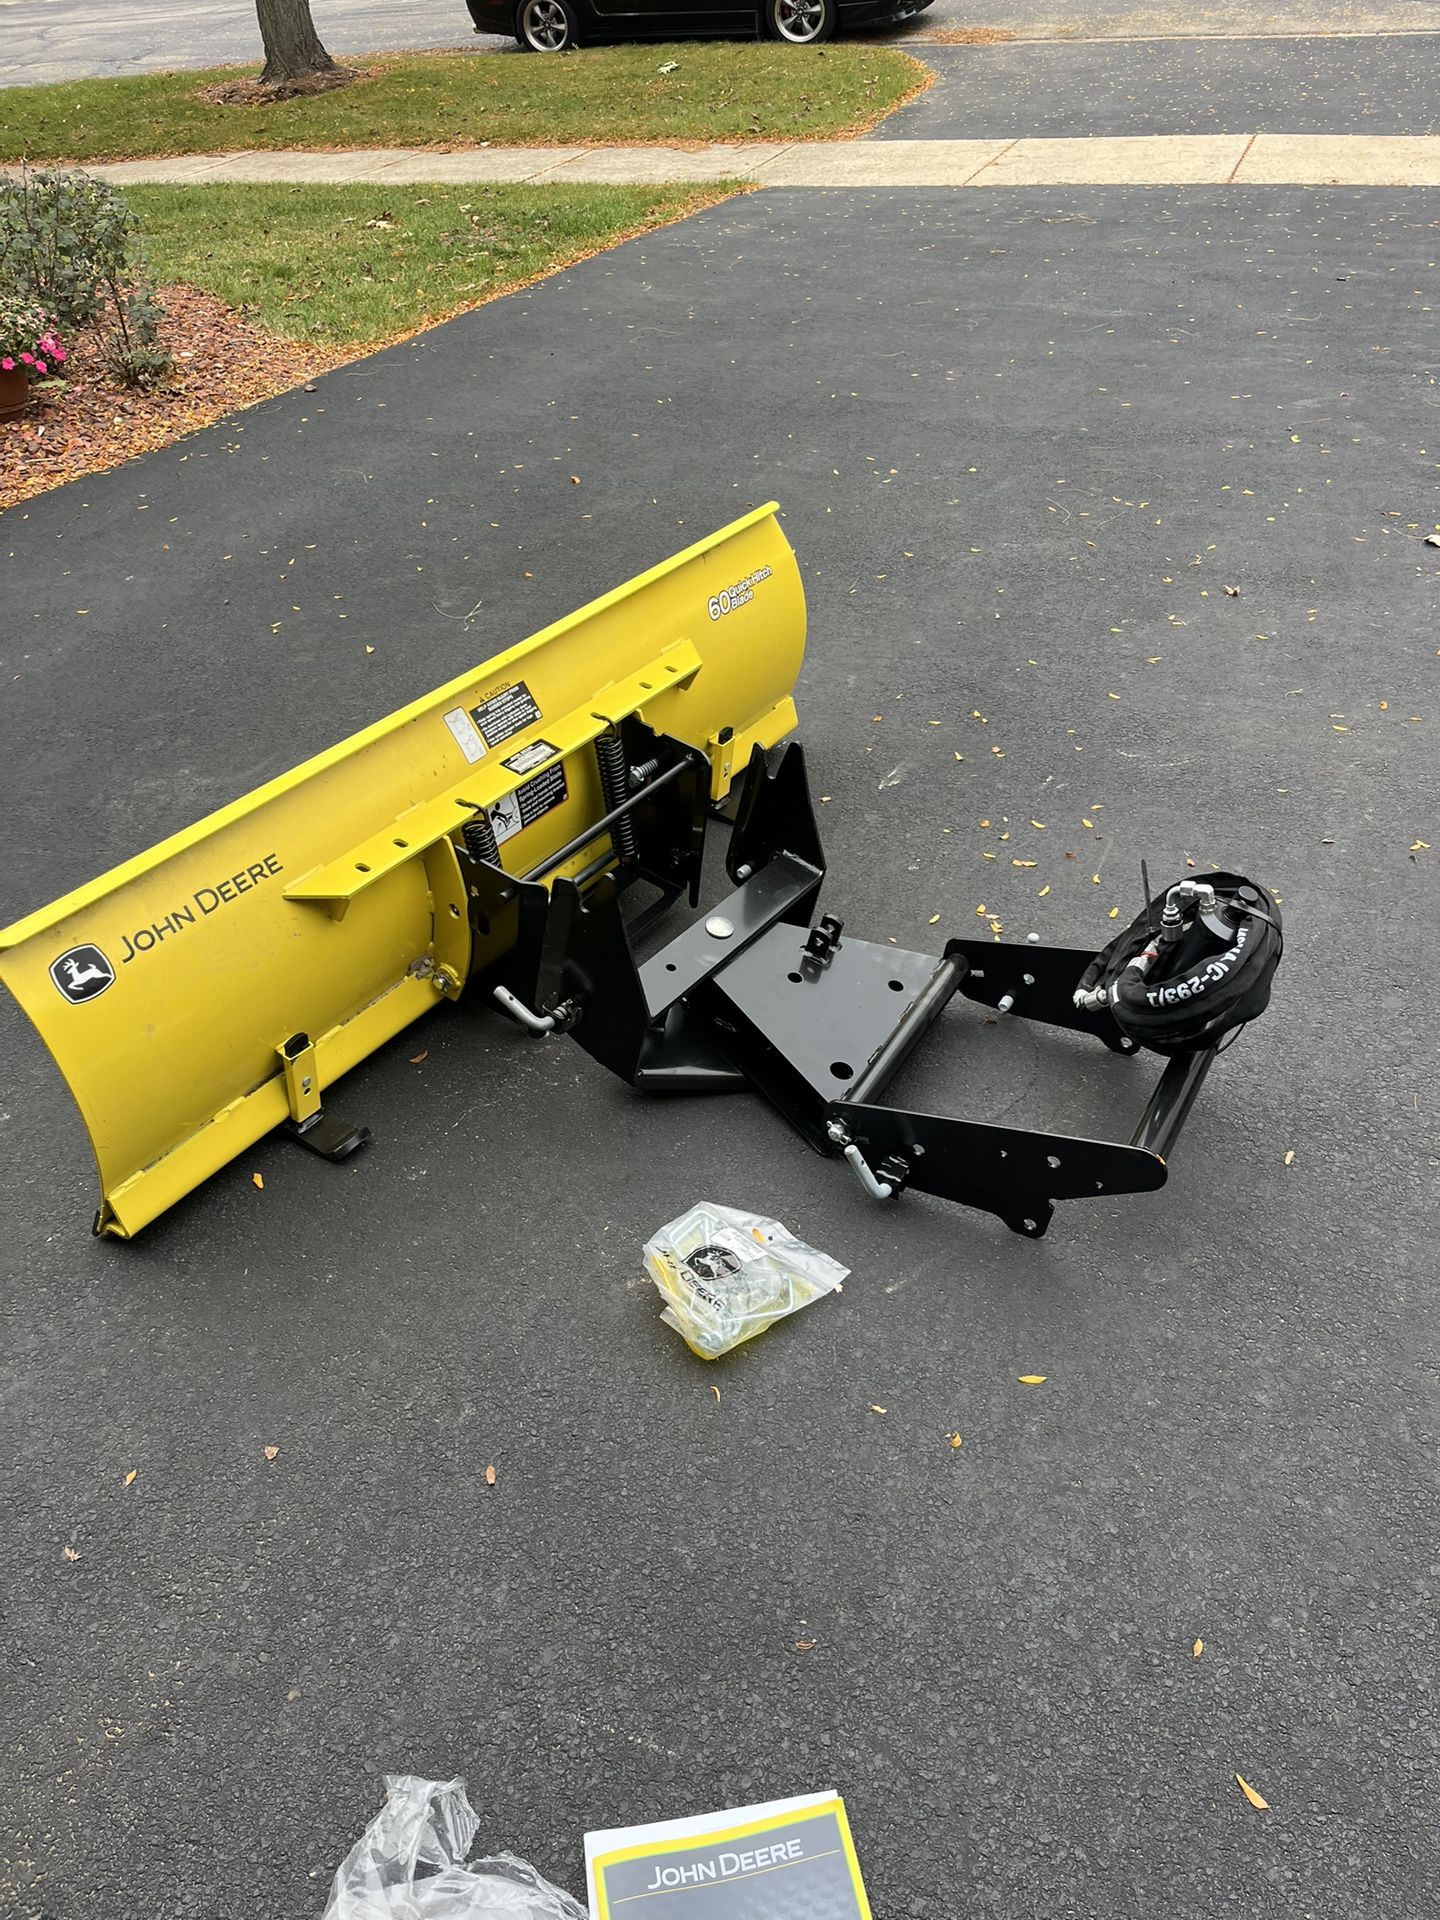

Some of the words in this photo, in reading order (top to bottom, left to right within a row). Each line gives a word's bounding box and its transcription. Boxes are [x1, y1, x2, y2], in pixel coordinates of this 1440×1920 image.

[708, 590, 731, 621] 60
[731, 589, 754, 611] Blade
[485, 681, 511, 699] CAUTION
[518, 784, 530, 796] Avoid
[530, 772, 550, 787] Crushing
[550, 764, 561, 774] From
[550, 771, 562, 781] Blade
[121, 905, 196, 964] JOHN
[193, 853, 283, 916] DEERE
[647, 1860, 716, 1890] JOHN
[719, 1838, 804, 1877] DEERE
